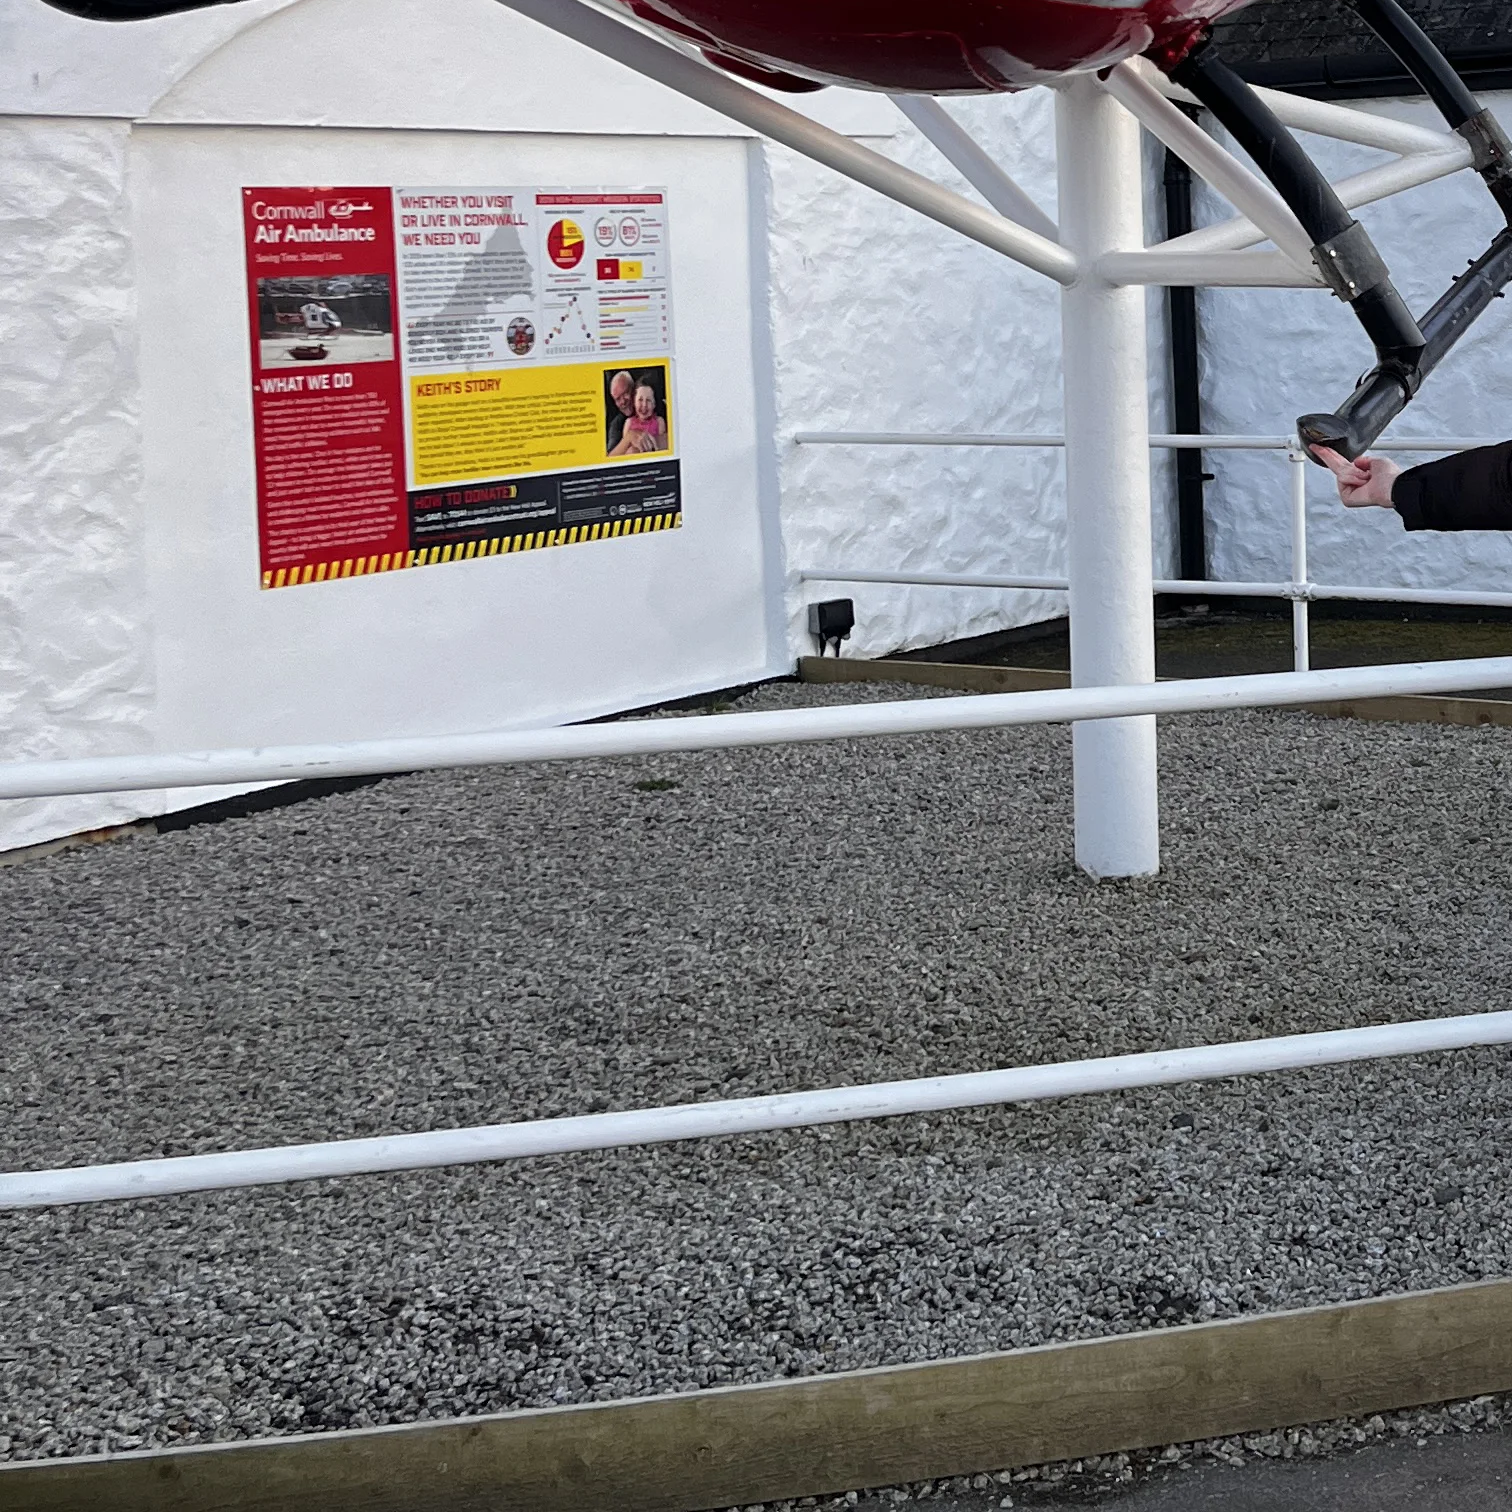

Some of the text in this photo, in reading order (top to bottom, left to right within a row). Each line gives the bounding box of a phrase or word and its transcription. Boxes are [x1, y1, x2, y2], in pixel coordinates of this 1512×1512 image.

[251, 200, 325, 220] Cornwall
[400, 195, 514, 209] WHETHER YOU VISIT
[402, 215, 418, 228] OR
[421, 214, 447, 228] LIVE
[449, 214, 462, 227] IN
[253, 223, 377, 244] Air Ambulance
[401, 232, 481, 246] WE NEED YOU
[260, 372, 354, 394] WHAT WE DO
[415, 378, 502, 397] KEITH'S STORY
[414, 486, 511, 509] HOW TO DONATE
